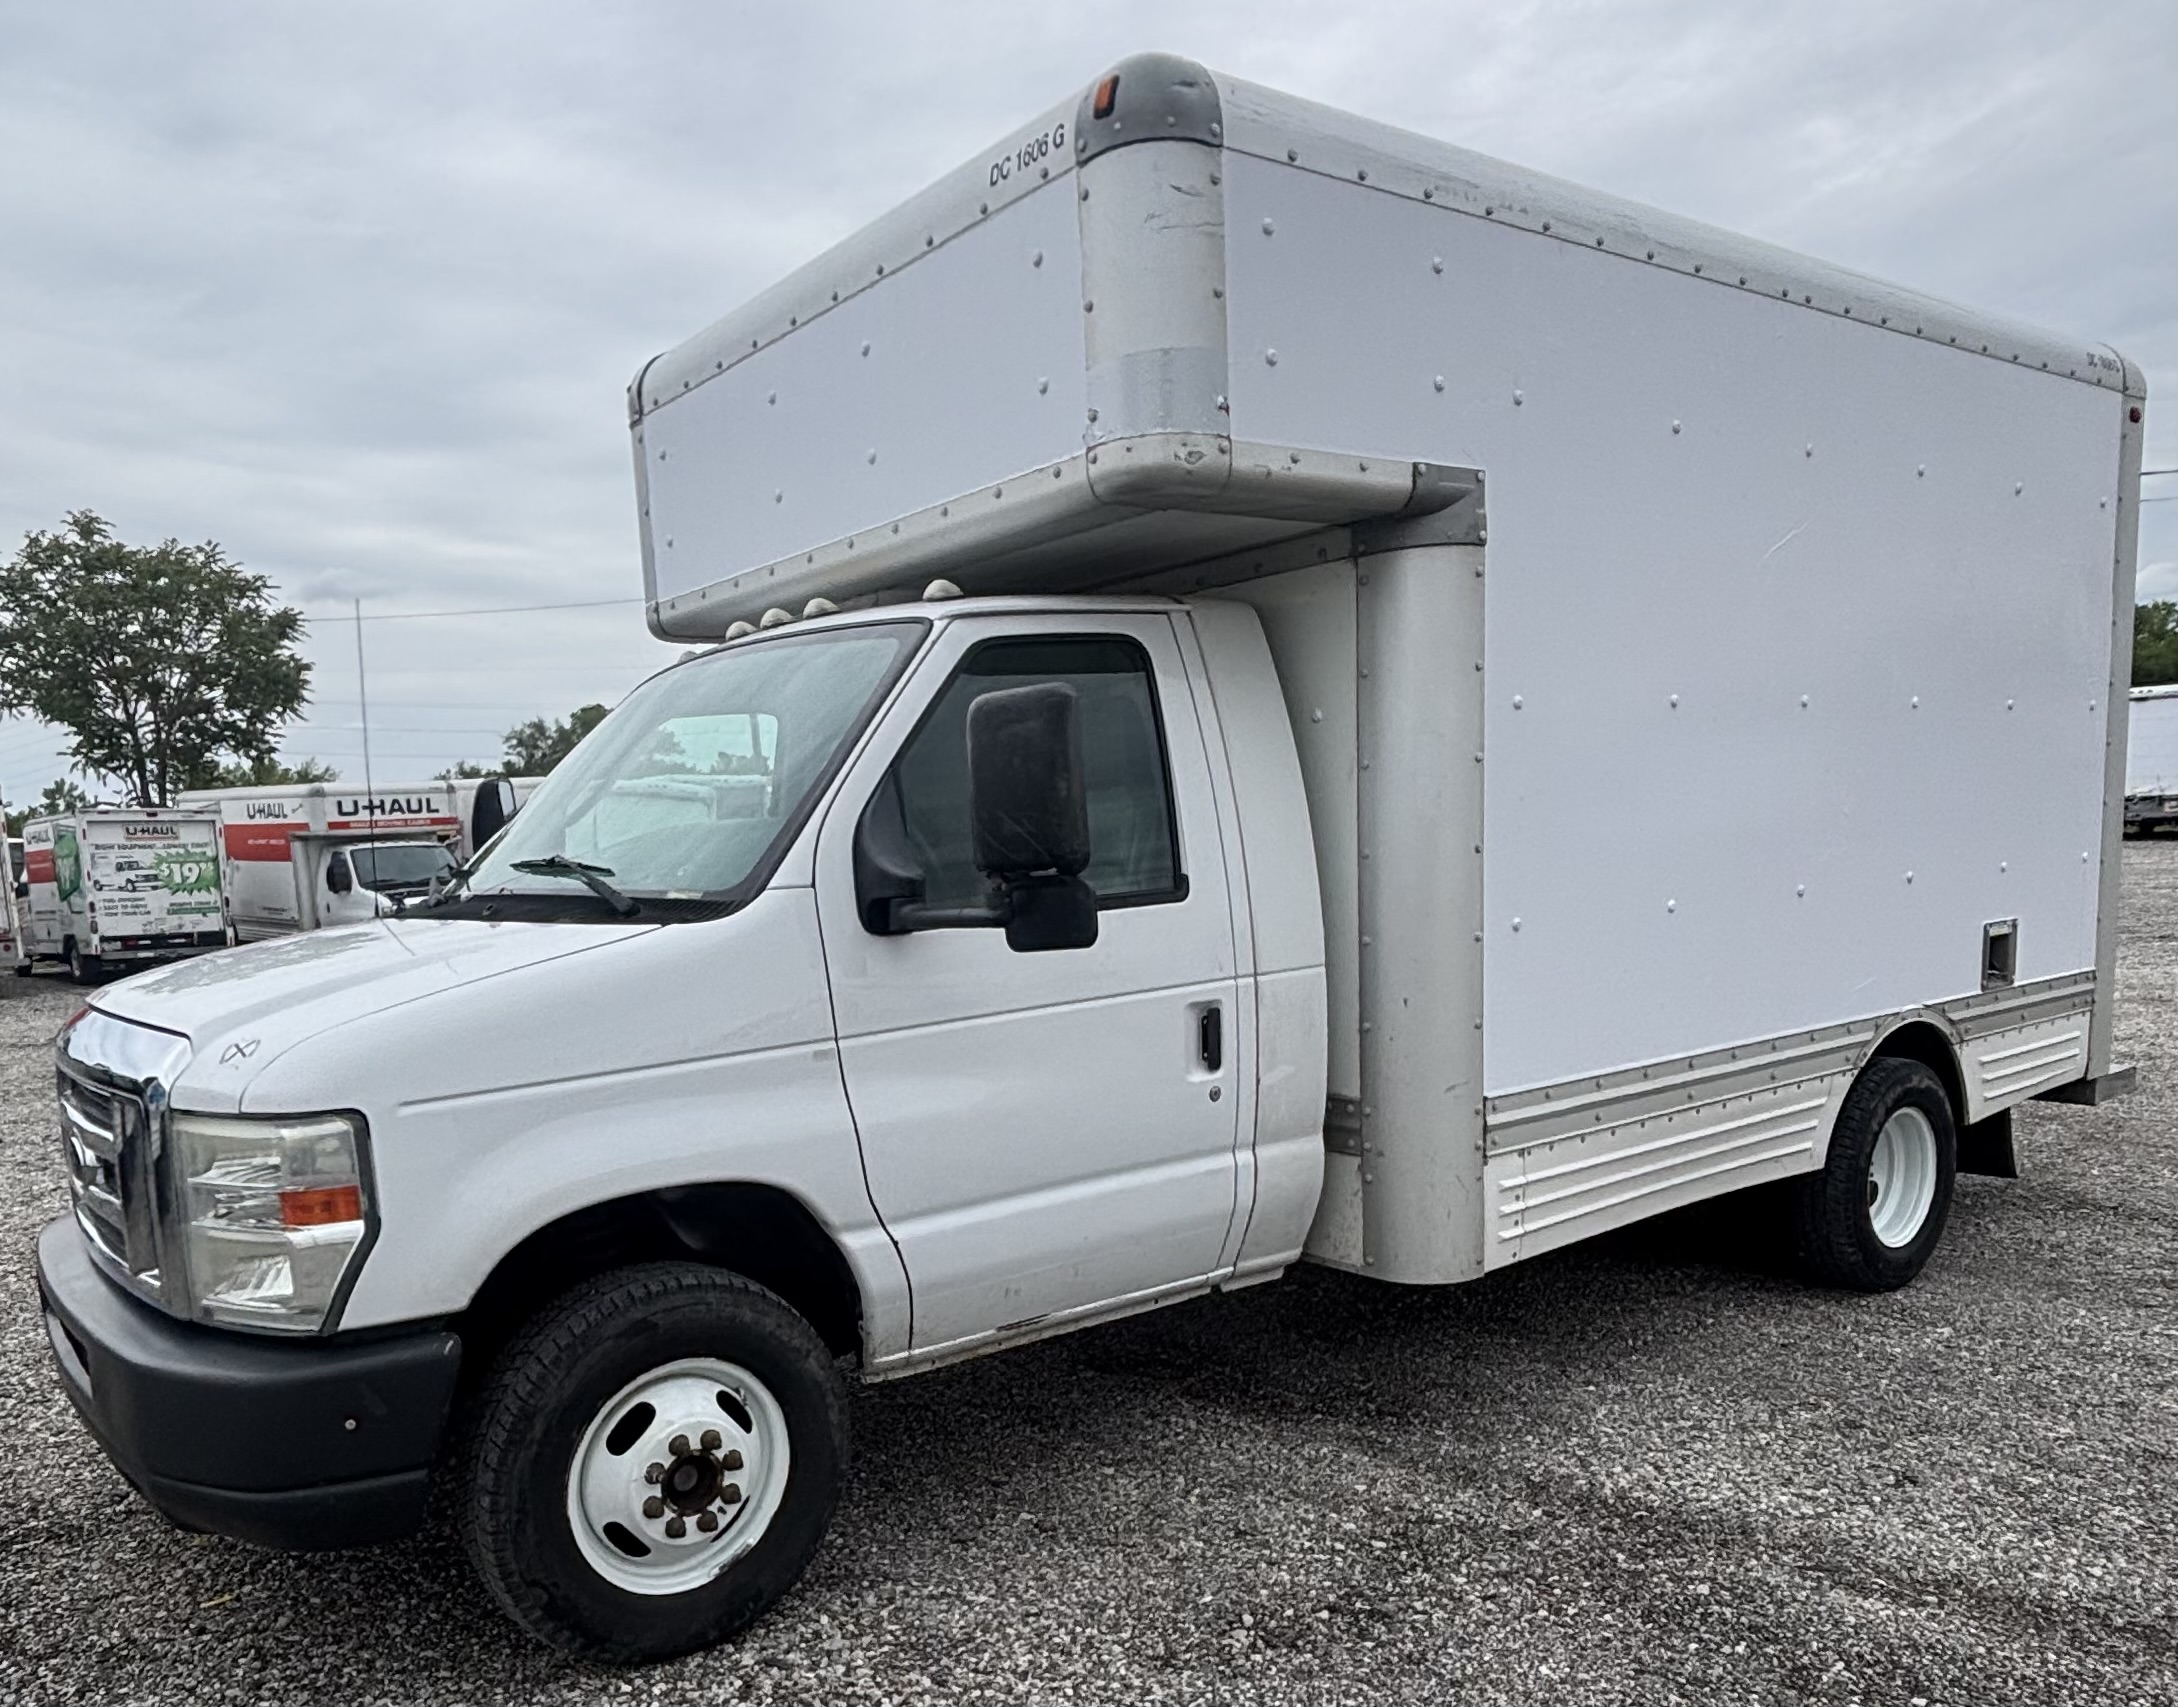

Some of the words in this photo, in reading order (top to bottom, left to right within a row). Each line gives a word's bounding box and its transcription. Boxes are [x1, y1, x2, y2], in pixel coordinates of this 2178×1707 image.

[990, 155, 1011, 187] DC
[1016, 132, 1049, 172] 1606
[1053, 123, 1065, 149] G
[246, 802, 288, 820] U-HAUL
[336, 797, 440, 817] U-HAUL
[125, 826, 177, 836] U-HAUL
